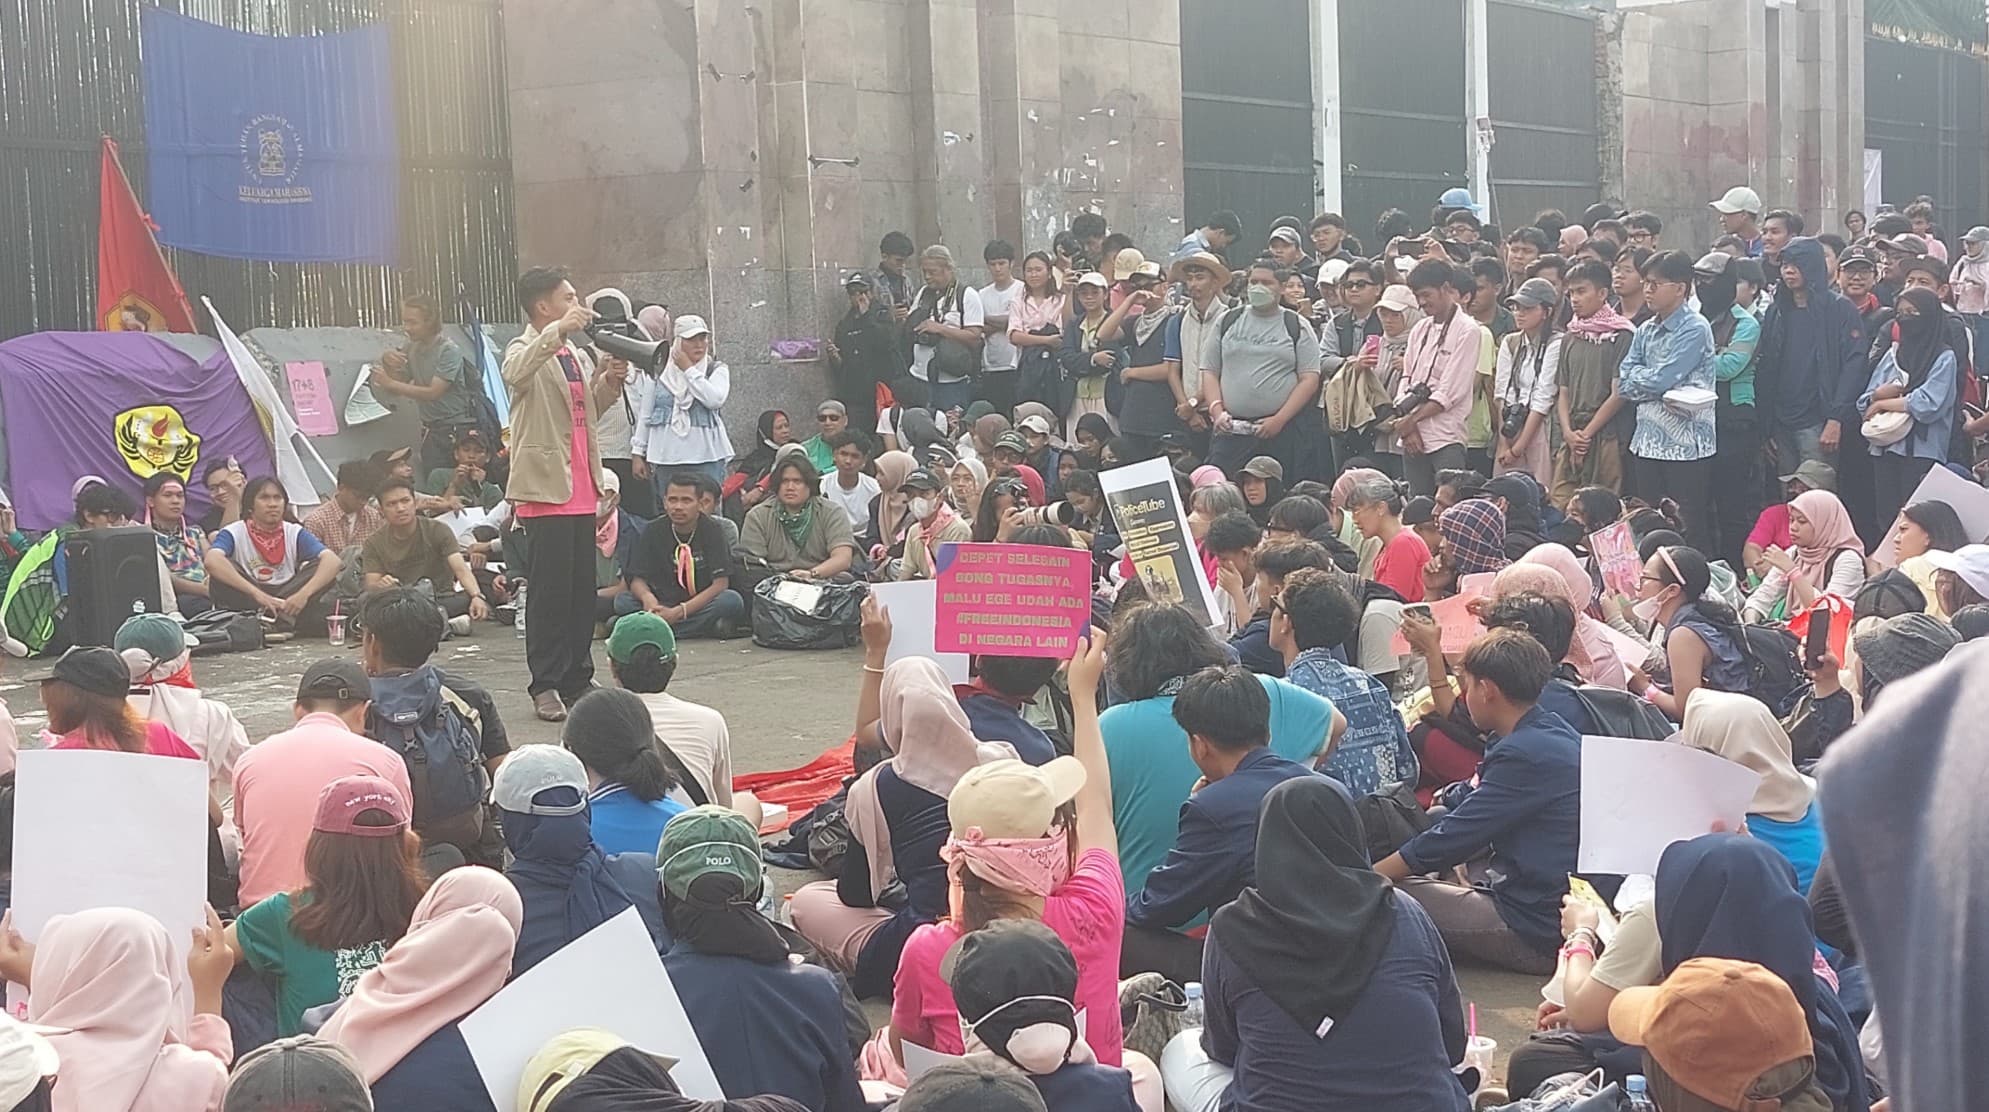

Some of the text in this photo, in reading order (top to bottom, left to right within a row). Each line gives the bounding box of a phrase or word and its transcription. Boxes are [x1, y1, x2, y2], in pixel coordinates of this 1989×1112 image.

[944, 593, 981, 604] MALU
[1017, 595, 1054, 607] UDAH
[1058, 597, 1084, 609] ADA
[956, 612, 1072, 627] #FREEINDONESIA
[959, 632, 1068, 648] DI NEGARA LAIN
[706, 856, 731, 866] POLO
